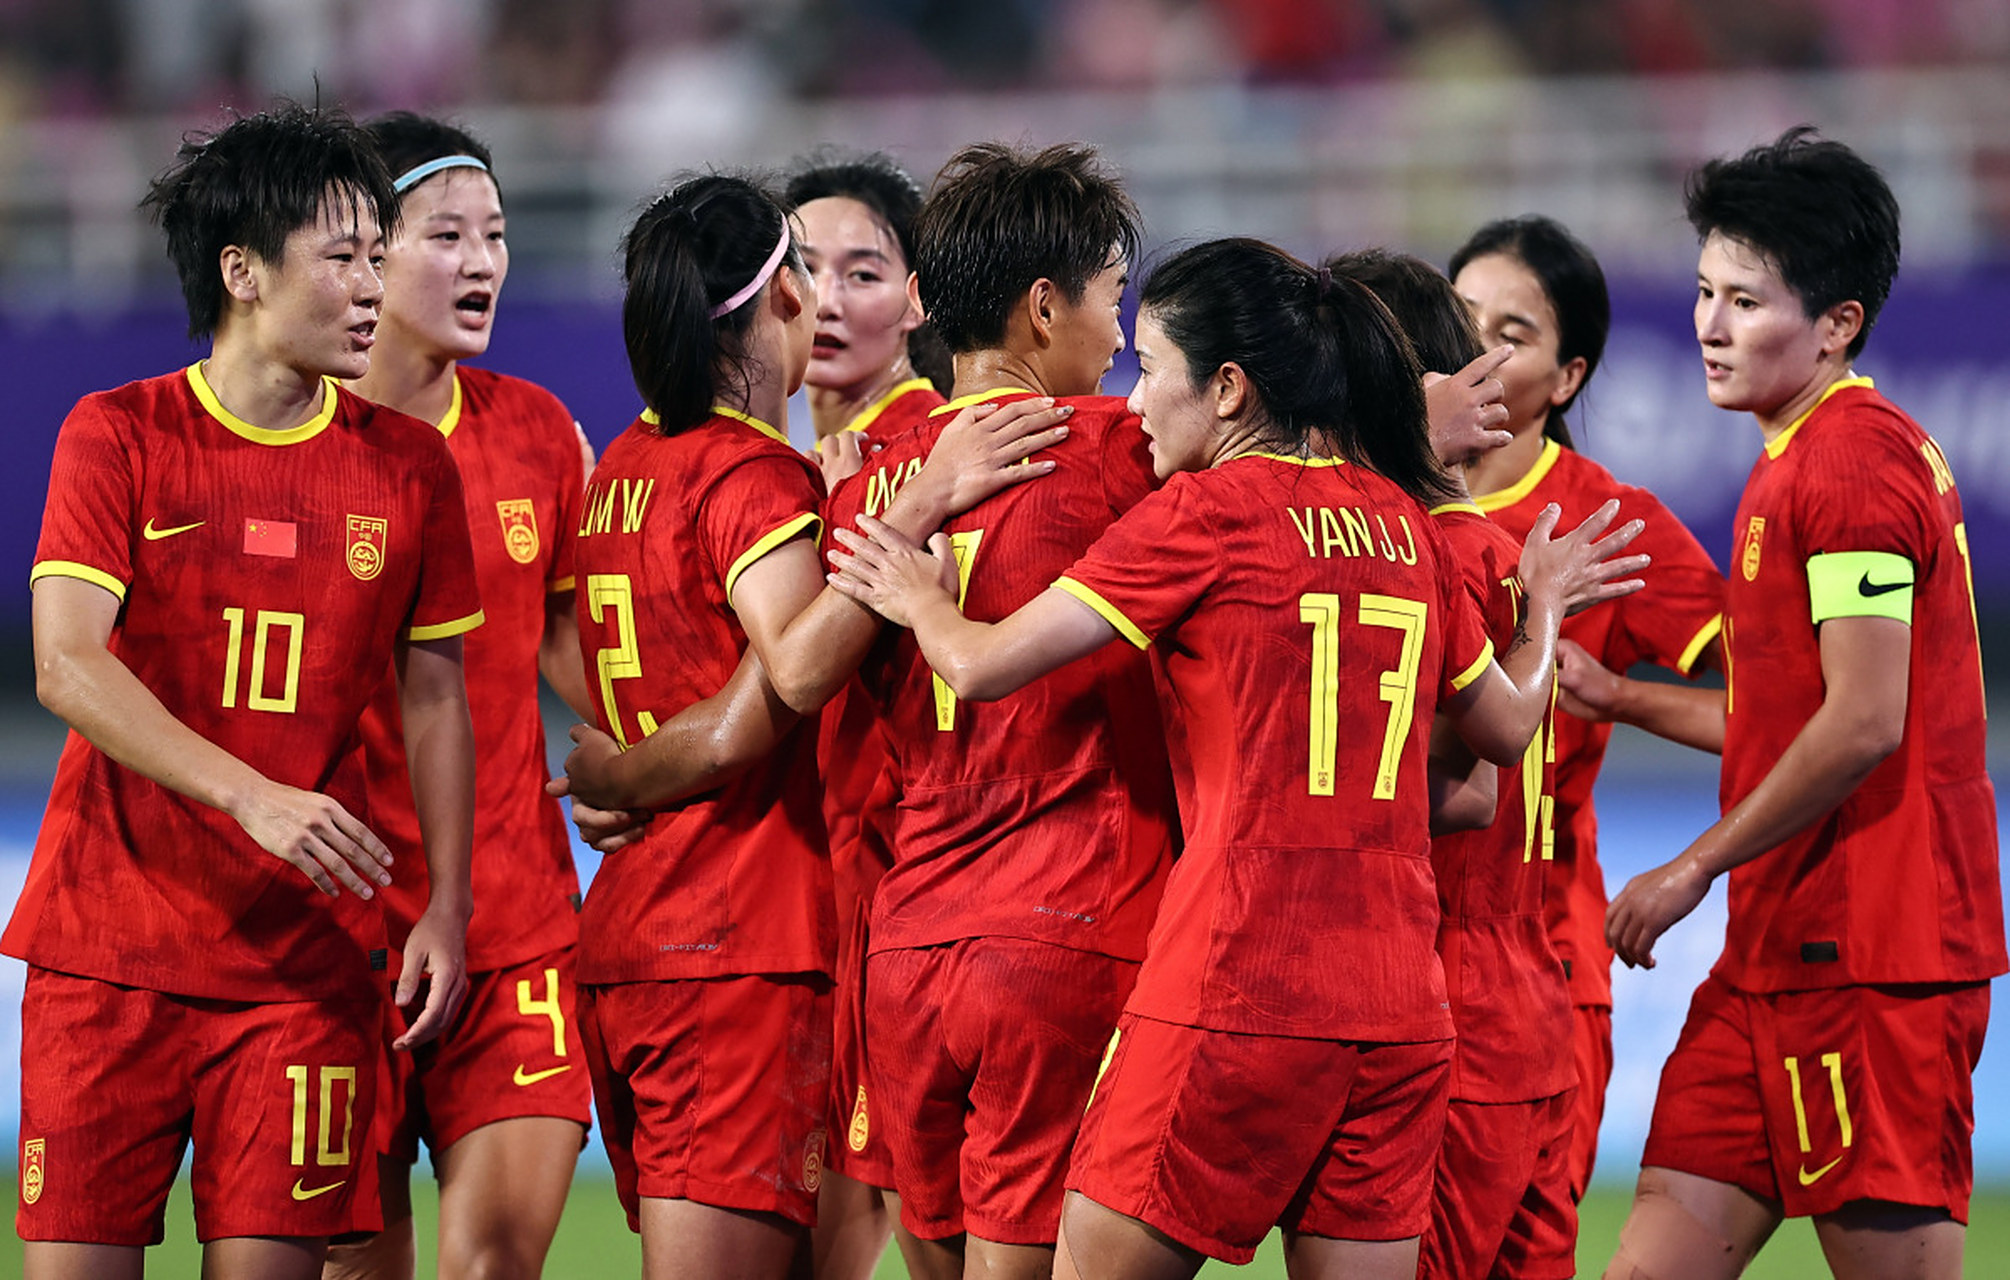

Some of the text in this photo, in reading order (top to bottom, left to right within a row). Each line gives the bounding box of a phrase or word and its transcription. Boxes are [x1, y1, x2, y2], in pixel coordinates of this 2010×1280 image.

[350, 519, 383, 534] CFA
[1286, 506, 1376, 559] YAN
[222, 607, 305, 714] 10
[1299, 592, 1428, 801] 17
[516, 968, 567, 1057] 4
[286, 1065, 356, 1166] 10
[1784, 1052, 1853, 1153] 11
